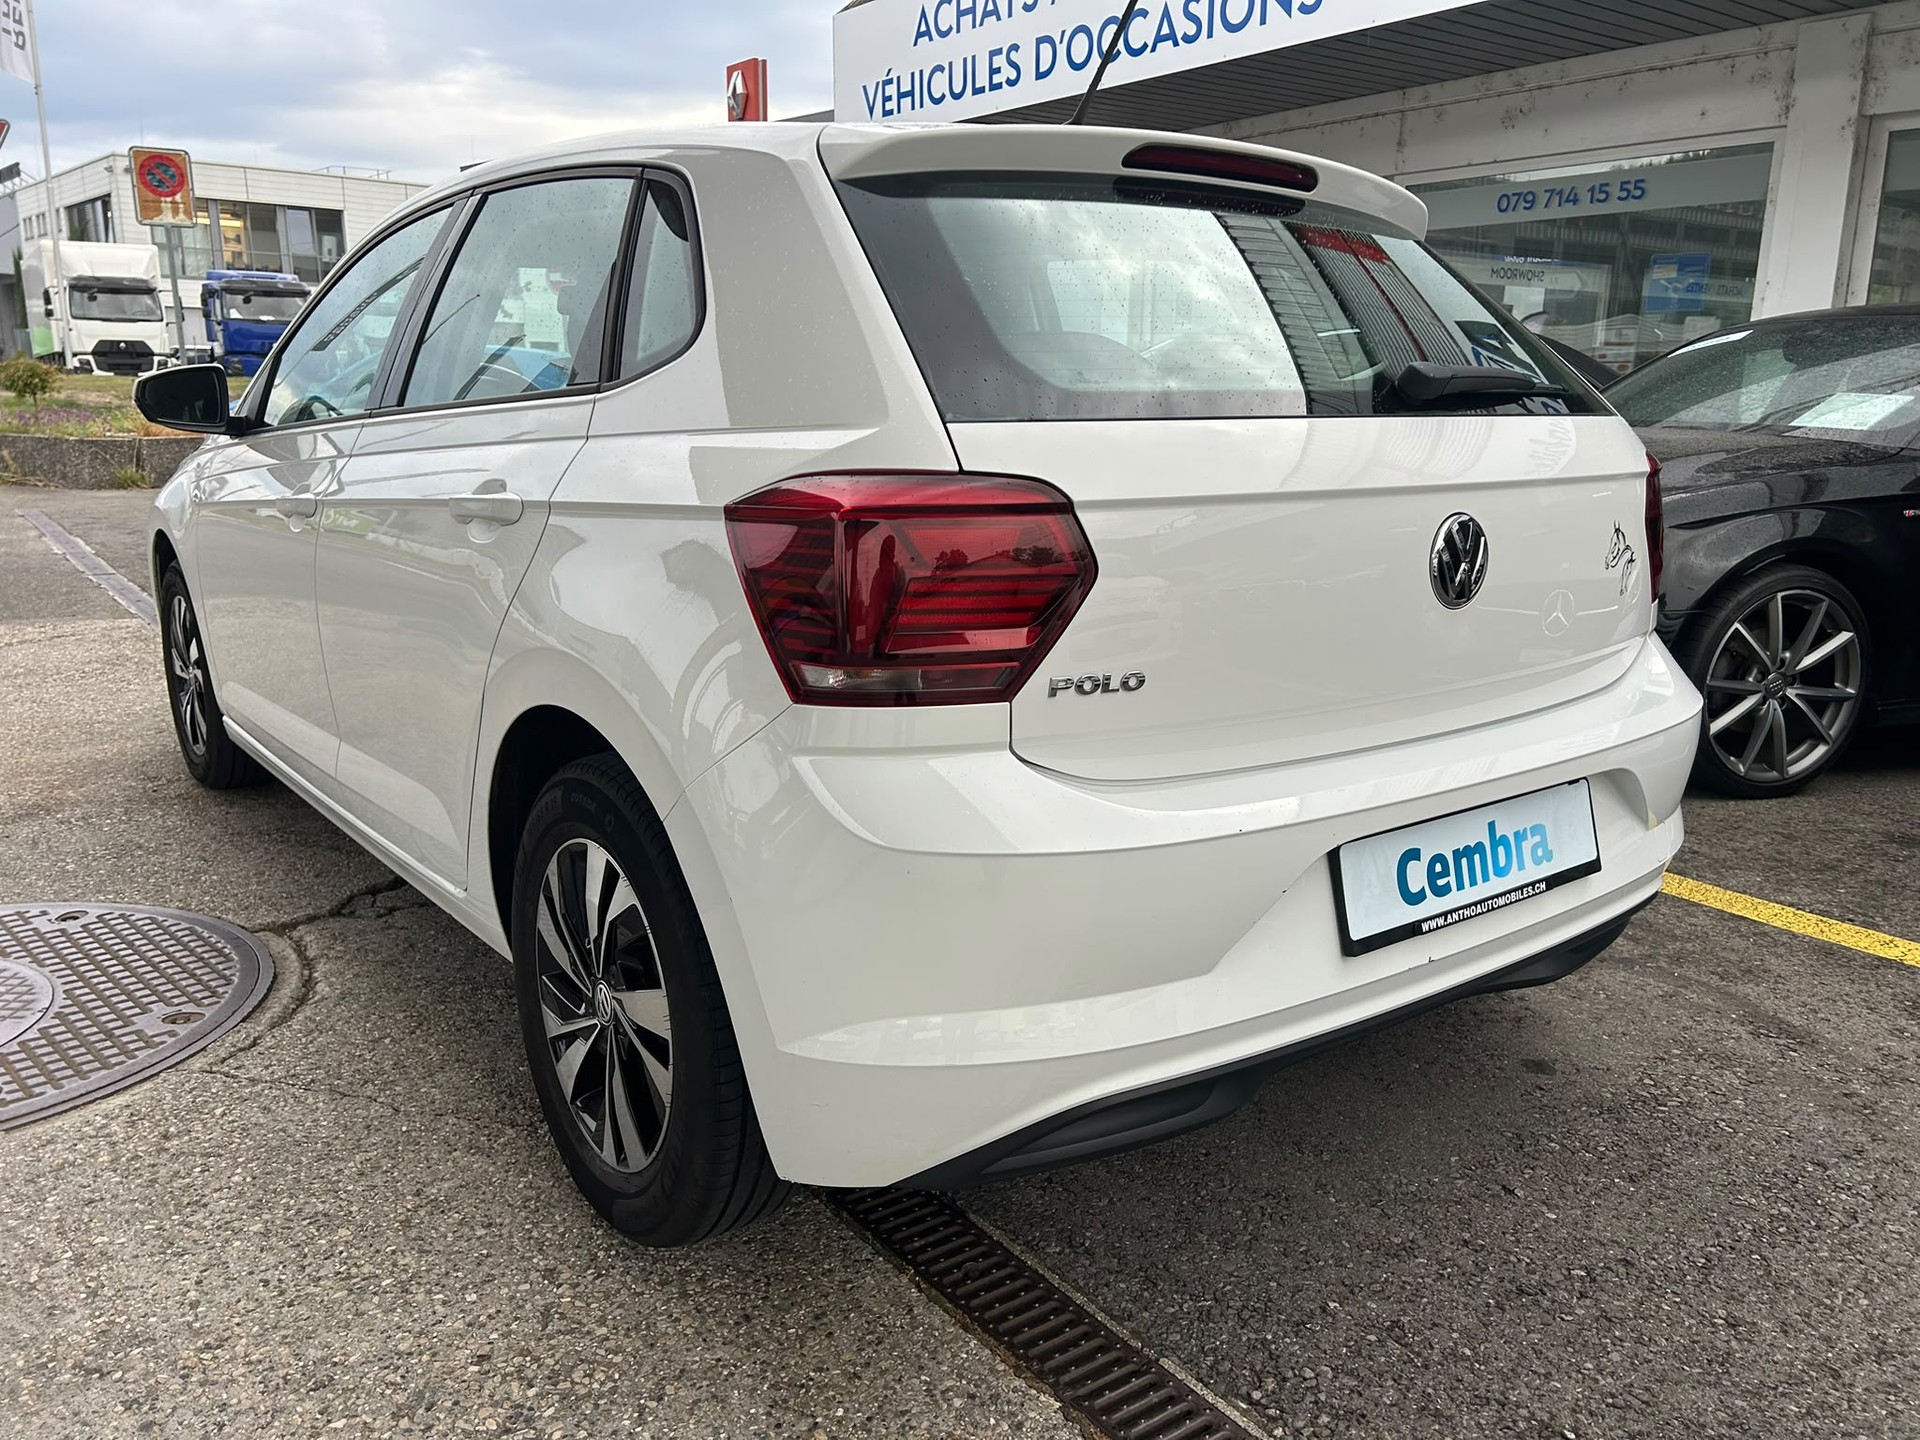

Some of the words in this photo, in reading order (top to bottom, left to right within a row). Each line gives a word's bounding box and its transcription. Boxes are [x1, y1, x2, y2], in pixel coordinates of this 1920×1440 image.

[862, 43, 1021, 121] VÉHICULES
[1497, 190, 1536, 213] 079
[1544, 185, 1579, 209] 714
[1587, 182, 1609, 204] 15
[1617, 178, 1646, 201] 55
[1048, 670, 1146, 698] POLO
[1396, 819, 1554, 907] Cembra
[1420, 881, 1547, 933] WWW.ANTHOAUTOMOBILES.CH
